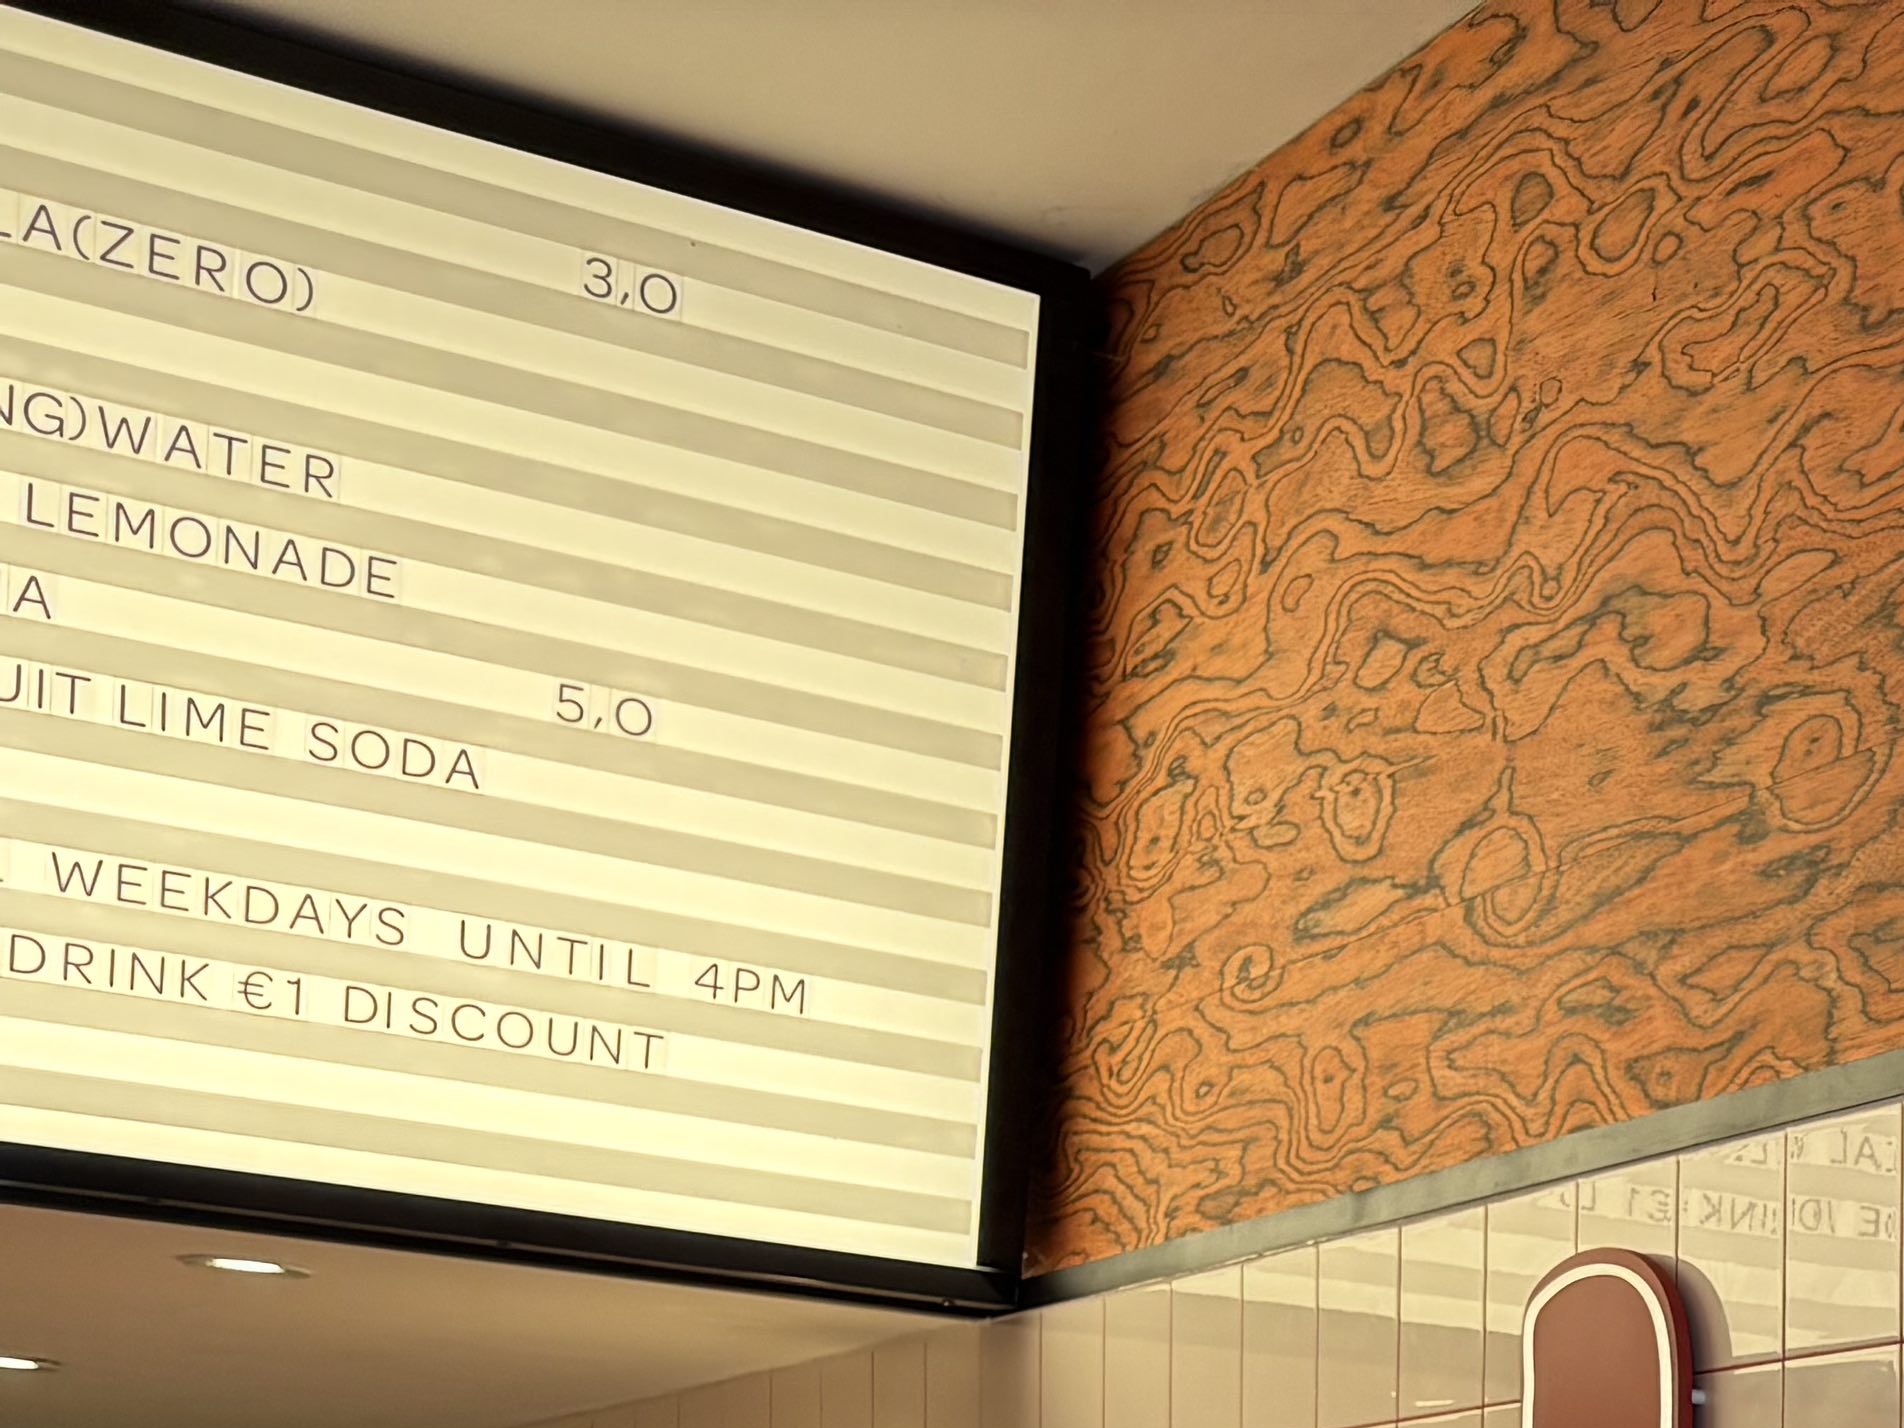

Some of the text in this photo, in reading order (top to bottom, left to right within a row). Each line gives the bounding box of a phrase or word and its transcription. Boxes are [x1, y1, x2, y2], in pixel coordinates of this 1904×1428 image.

[0, 203, 314, 312] A(ZERO)
[25, 481, 398, 599] LEMONADE
[118, 683, 271, 751] LIME
[308, 721, 480, 790] SODA
[51, 851, 806, 1015] WEEKDAYS UNTIL 4PM
[9, 933, 665, 1070] DRINK €1 DISCOUNT
